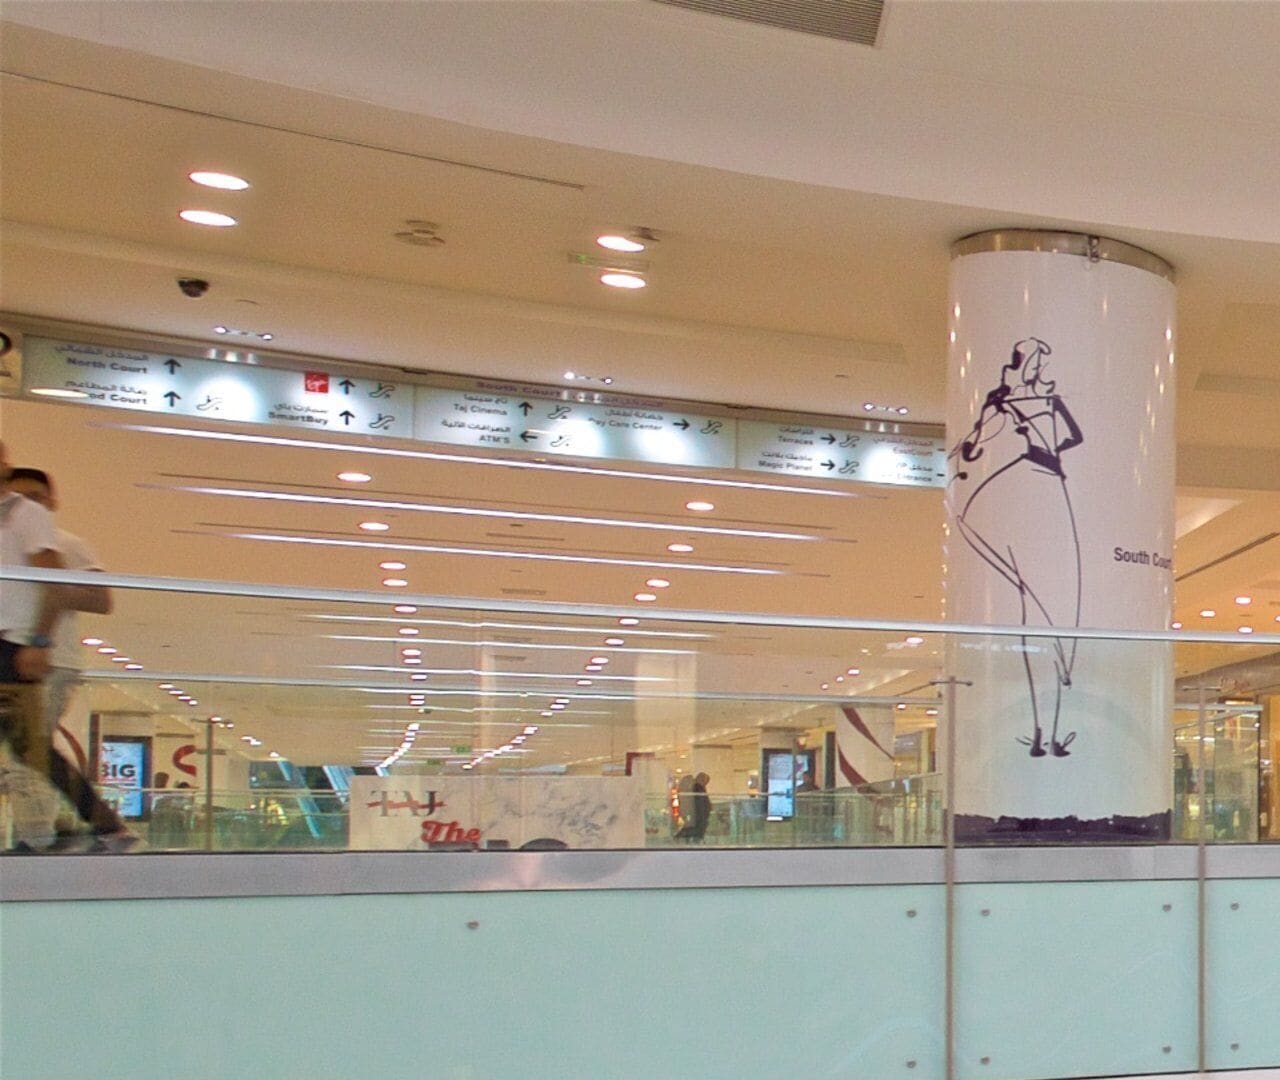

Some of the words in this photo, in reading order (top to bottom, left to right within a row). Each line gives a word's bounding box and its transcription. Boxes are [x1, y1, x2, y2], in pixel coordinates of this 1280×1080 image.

[66, 357, 106, 370] North
[110, 359, 148, 374] Court
[110, 393, 148, 405] Court
[453, 403, 468, 414] Taj
[470, 404, 508, 417] Cinema
[268, 411, 329, 426] SmartBuy
[632, 421, 663, 431] Center
[1113, 546, 1150, 566] South
[421, 820, 482, 844] The
